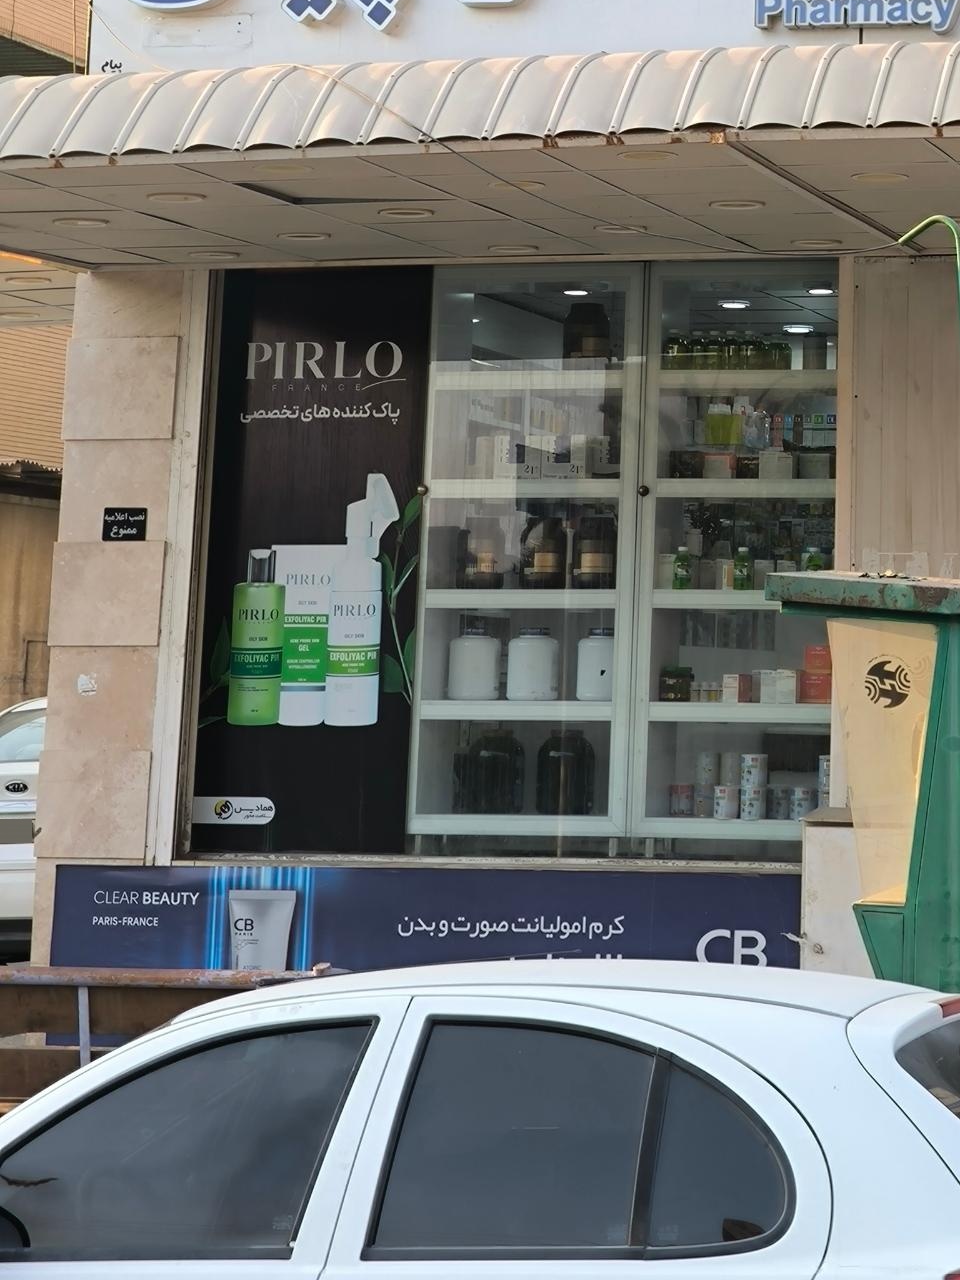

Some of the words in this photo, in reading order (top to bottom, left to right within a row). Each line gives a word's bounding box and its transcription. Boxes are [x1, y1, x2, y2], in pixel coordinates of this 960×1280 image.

[246, 341, 403, 380] PIRLO
[271, 383, 361, 392] FRANCE
[240, 404, 299, 424] تخصصی
[300, 404, 331, 422] های
[332, 402, 372, 419] کننده
[373, 402, 401, 425] پاک
[111, 525, 138, 537] ممنوع
[286, 573, 331, 586] PIRLO
[238, 608, 279, 621] PIRLO
[333, 603, 376, 617] PIRLO
[93, 890, 140, 905] CLEAR
[142, 891, 200, 906] BEAUTY
[92, 916, 159, 927] PARIS-FRANCE
[233, 918, 255, 932] CB
[397, 915, 436, 937] بدن
[450, 915, 509, 938] صورت
[511, 915, 587, 939] امولیانت
[588, 915, 625, 940] کرم
[695, 928, 768, 968] CB
